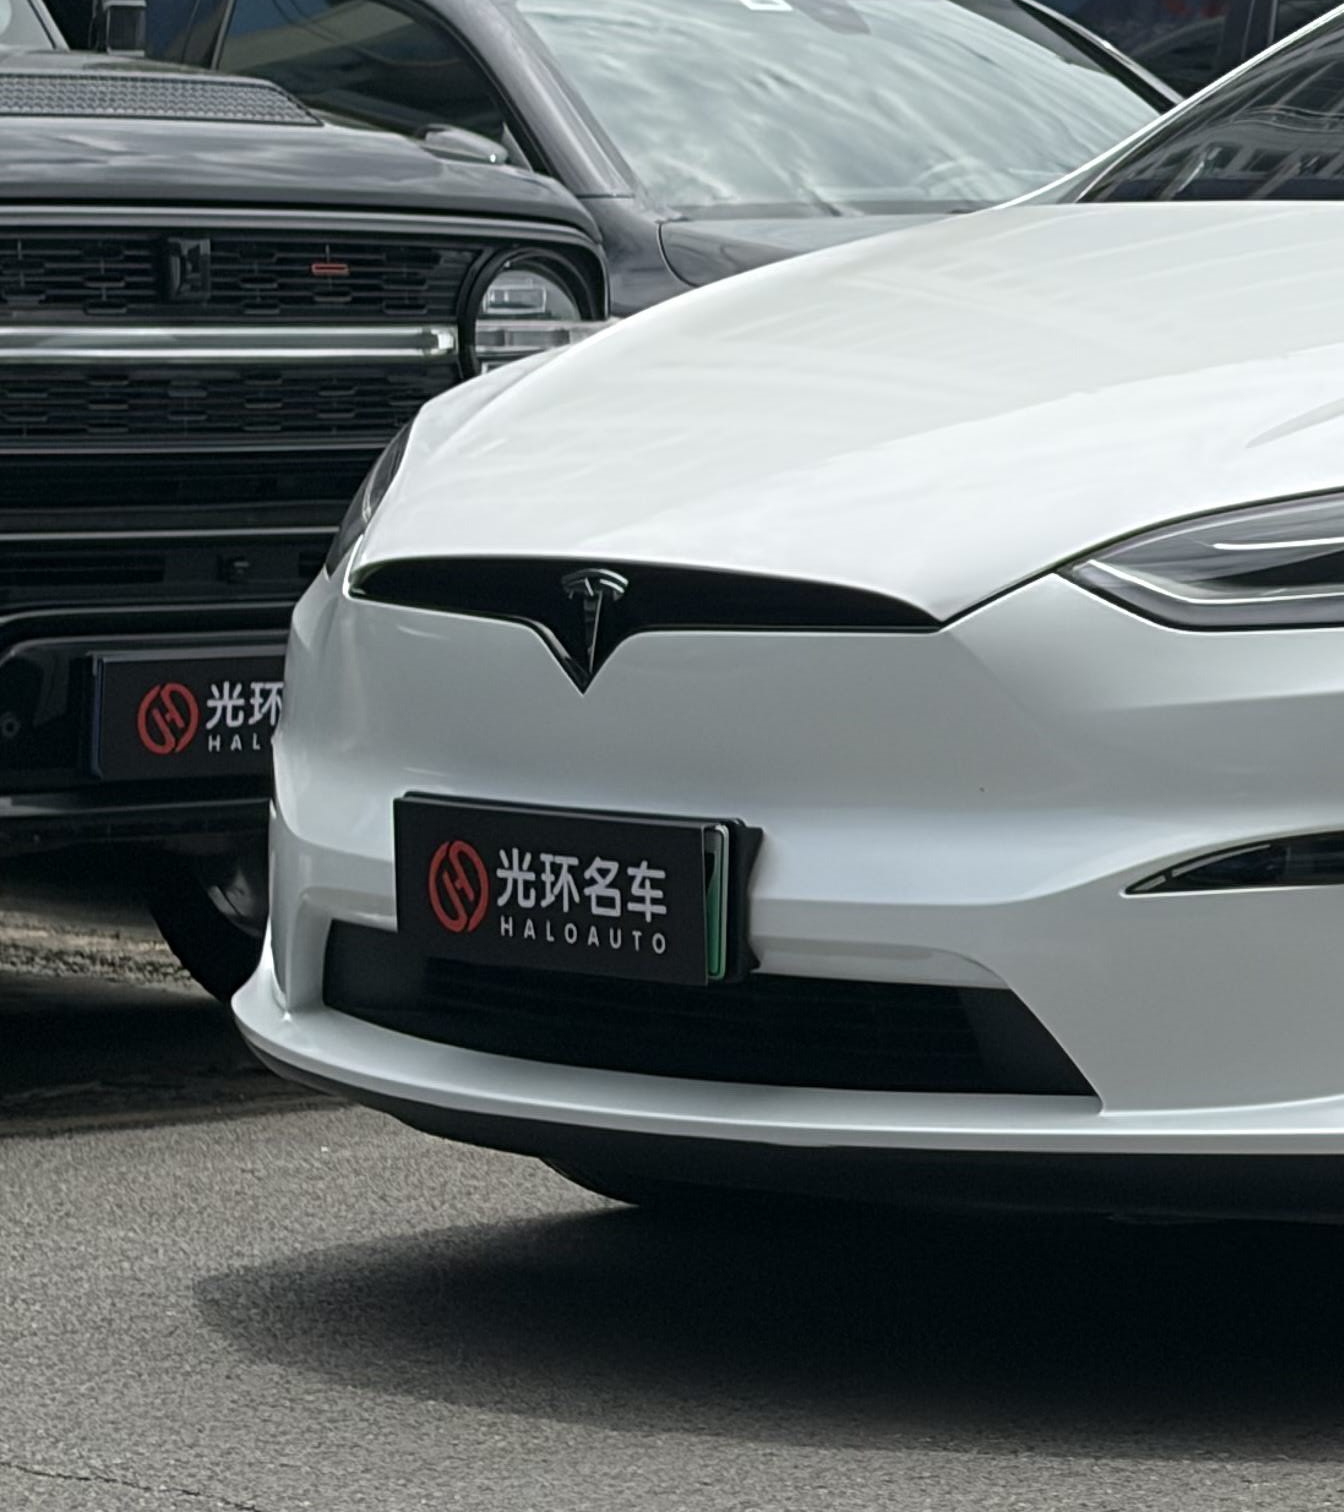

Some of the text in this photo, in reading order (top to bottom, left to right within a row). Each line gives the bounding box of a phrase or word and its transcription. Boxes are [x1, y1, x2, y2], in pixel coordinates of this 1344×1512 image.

[206, 680, 284, 729] 光环
[208, 732, 260, 751] HAL
[496, 847, 667, 922] 光环名车
[500, 915, 667, 955] HALOAUTO
